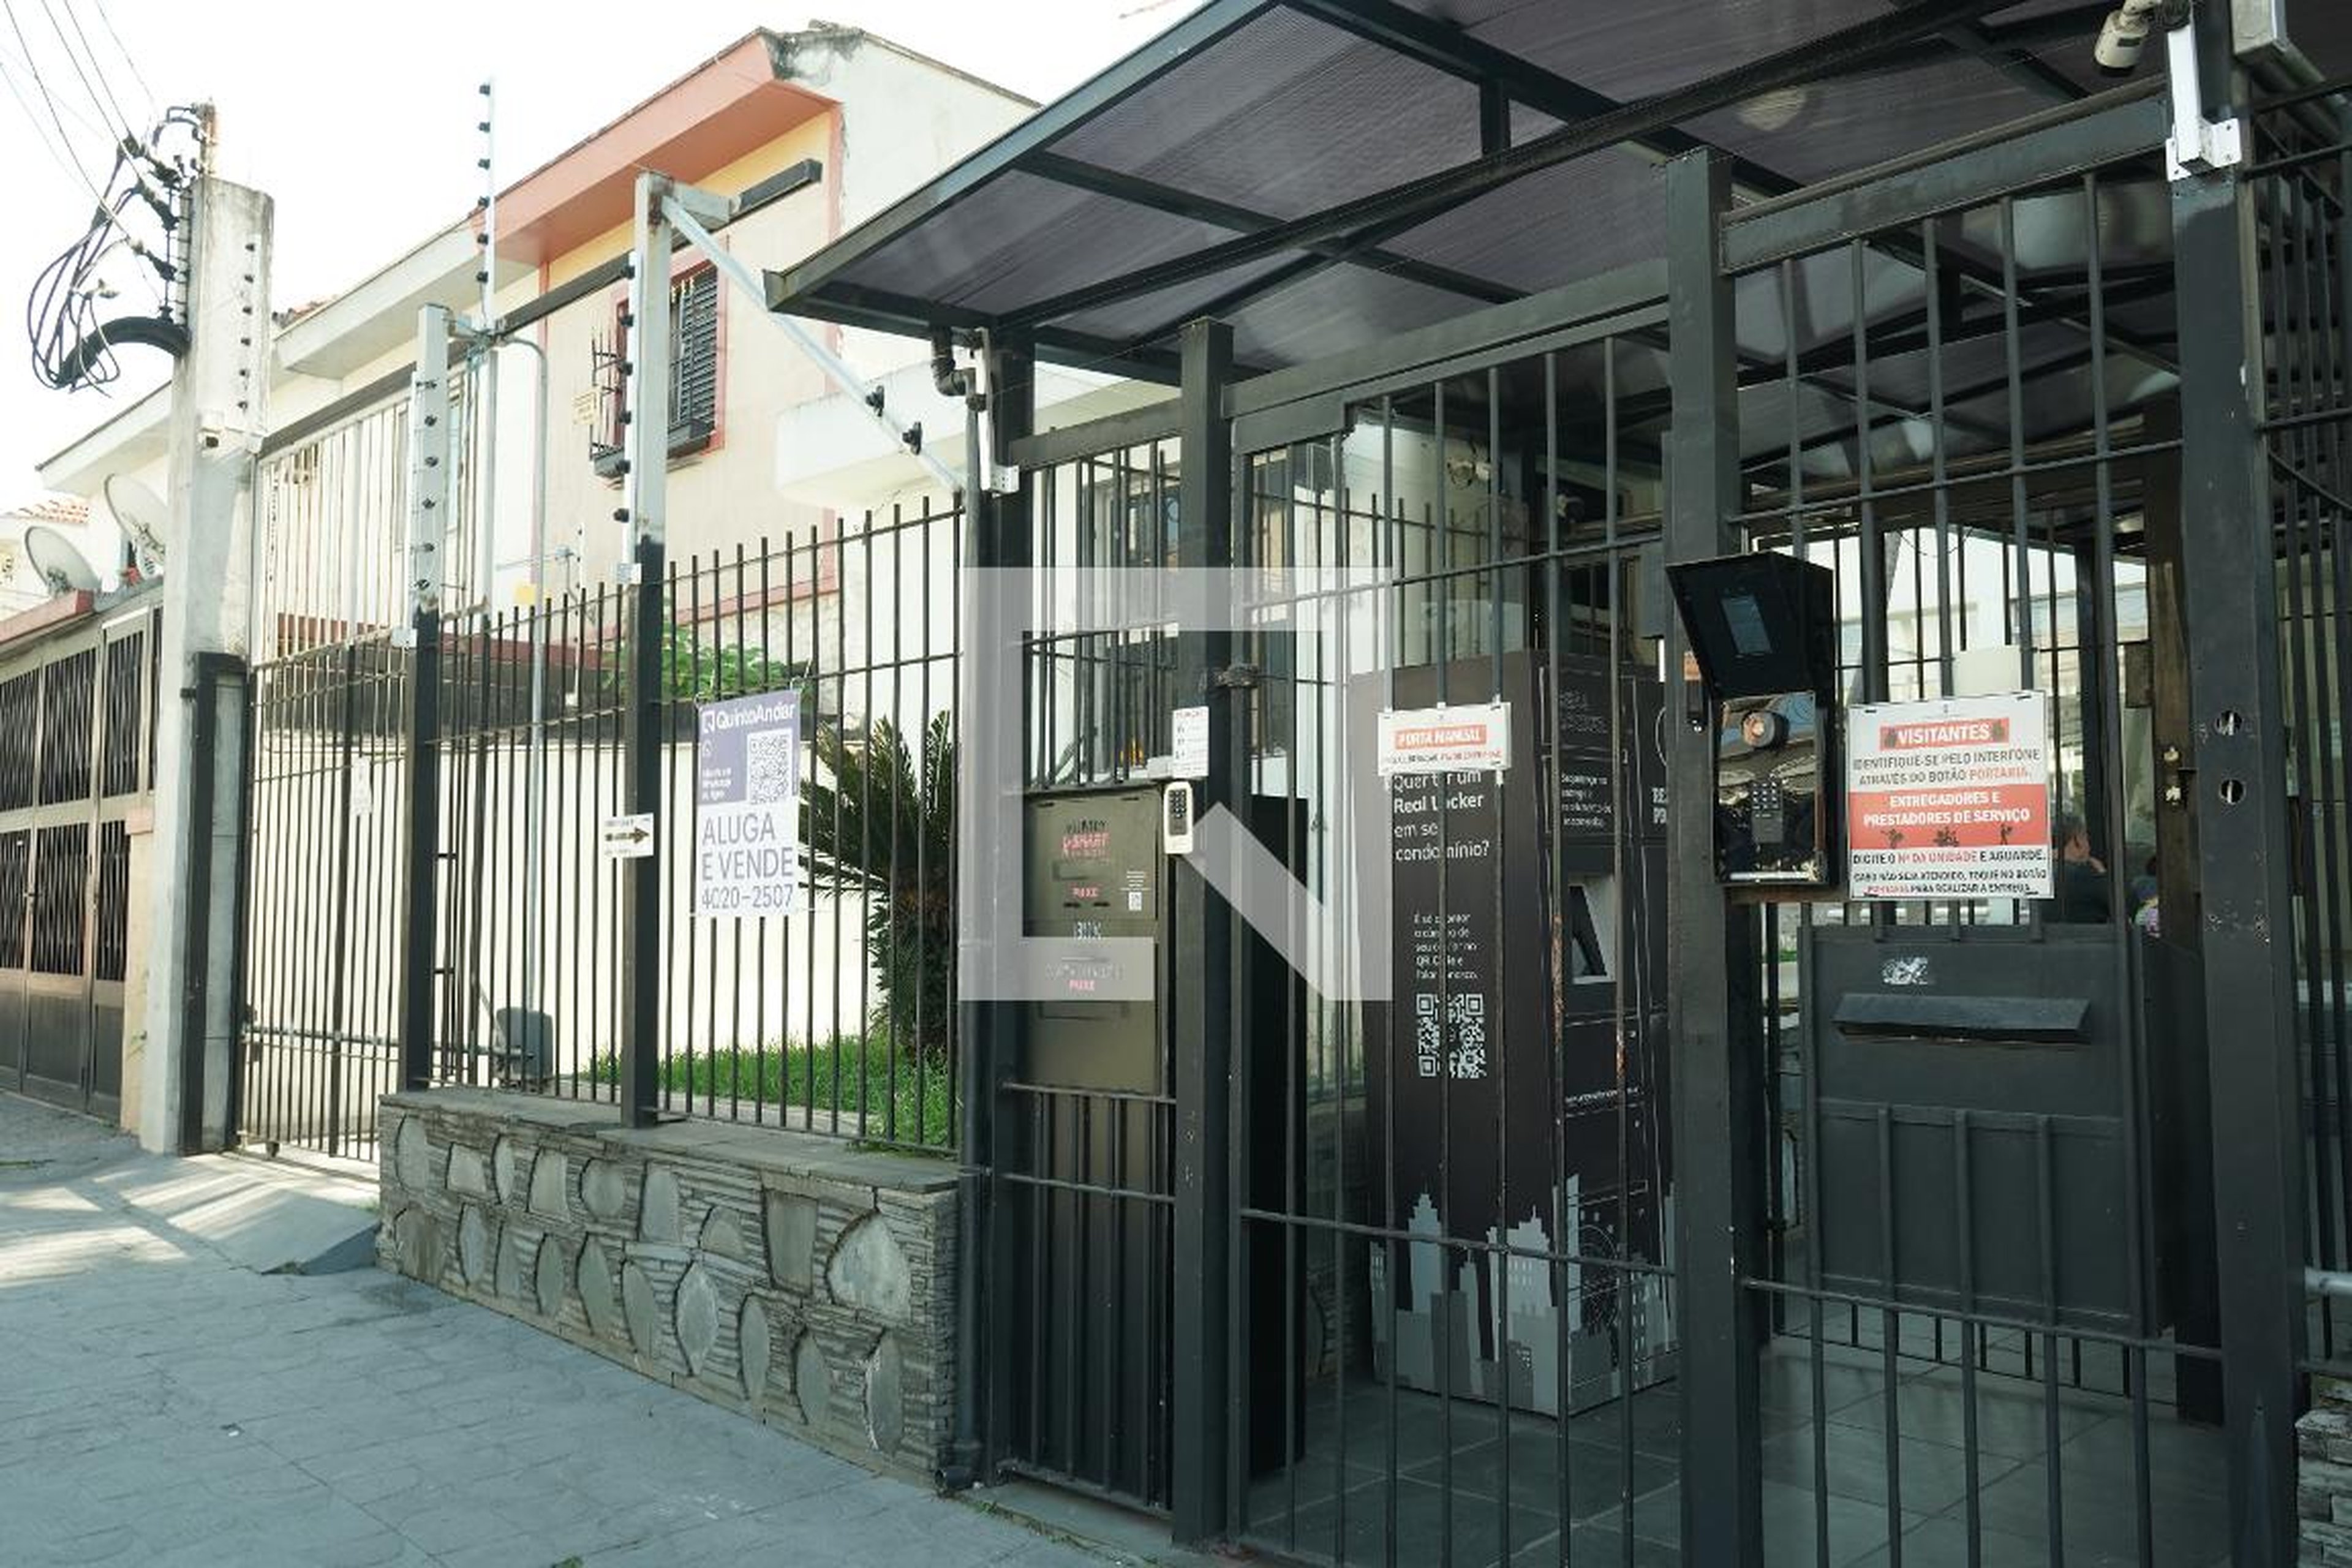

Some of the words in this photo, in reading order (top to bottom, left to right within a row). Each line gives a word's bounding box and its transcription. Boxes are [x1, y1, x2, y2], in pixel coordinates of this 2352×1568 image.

[717, 702, 795, 729] QuintoAndar
[1898, 723, 1990, 744] VISITANTES
[1942, 752, 1972, 764] PELO
[1973, 748, 2040, 762] INTERFONE
[1394, 775, 1428, 793] Quer
[1431, 772, 1453, 787] tr
[1457, 770, 1481, 785] um
[1910, 771, 1926, 782] DO
[1929, 766, 1966, 782] BOTÃO
[1394, 796, 1426, 813] Real
[1890, 792, 1989, 807] ENTREGADORES
[1992, 791, 2001, 803] E
[1863, 812, 1951, 826] PRESTADORES
[1954, 811, 1971, 823] DE
[703, 812, 775, 845] ALUGA
[1394, 825, 1415, 837] em
[703, 852, 713, 880] E
[718, 848, 793, 880] VENDE
[1853, 854, 1887, 864] DIGITE
[1980, 851, 1986, 862] E
[1989, 849, 2046, 862] AGUARDE.
[703, 884, 793, 909] 4020-2507
